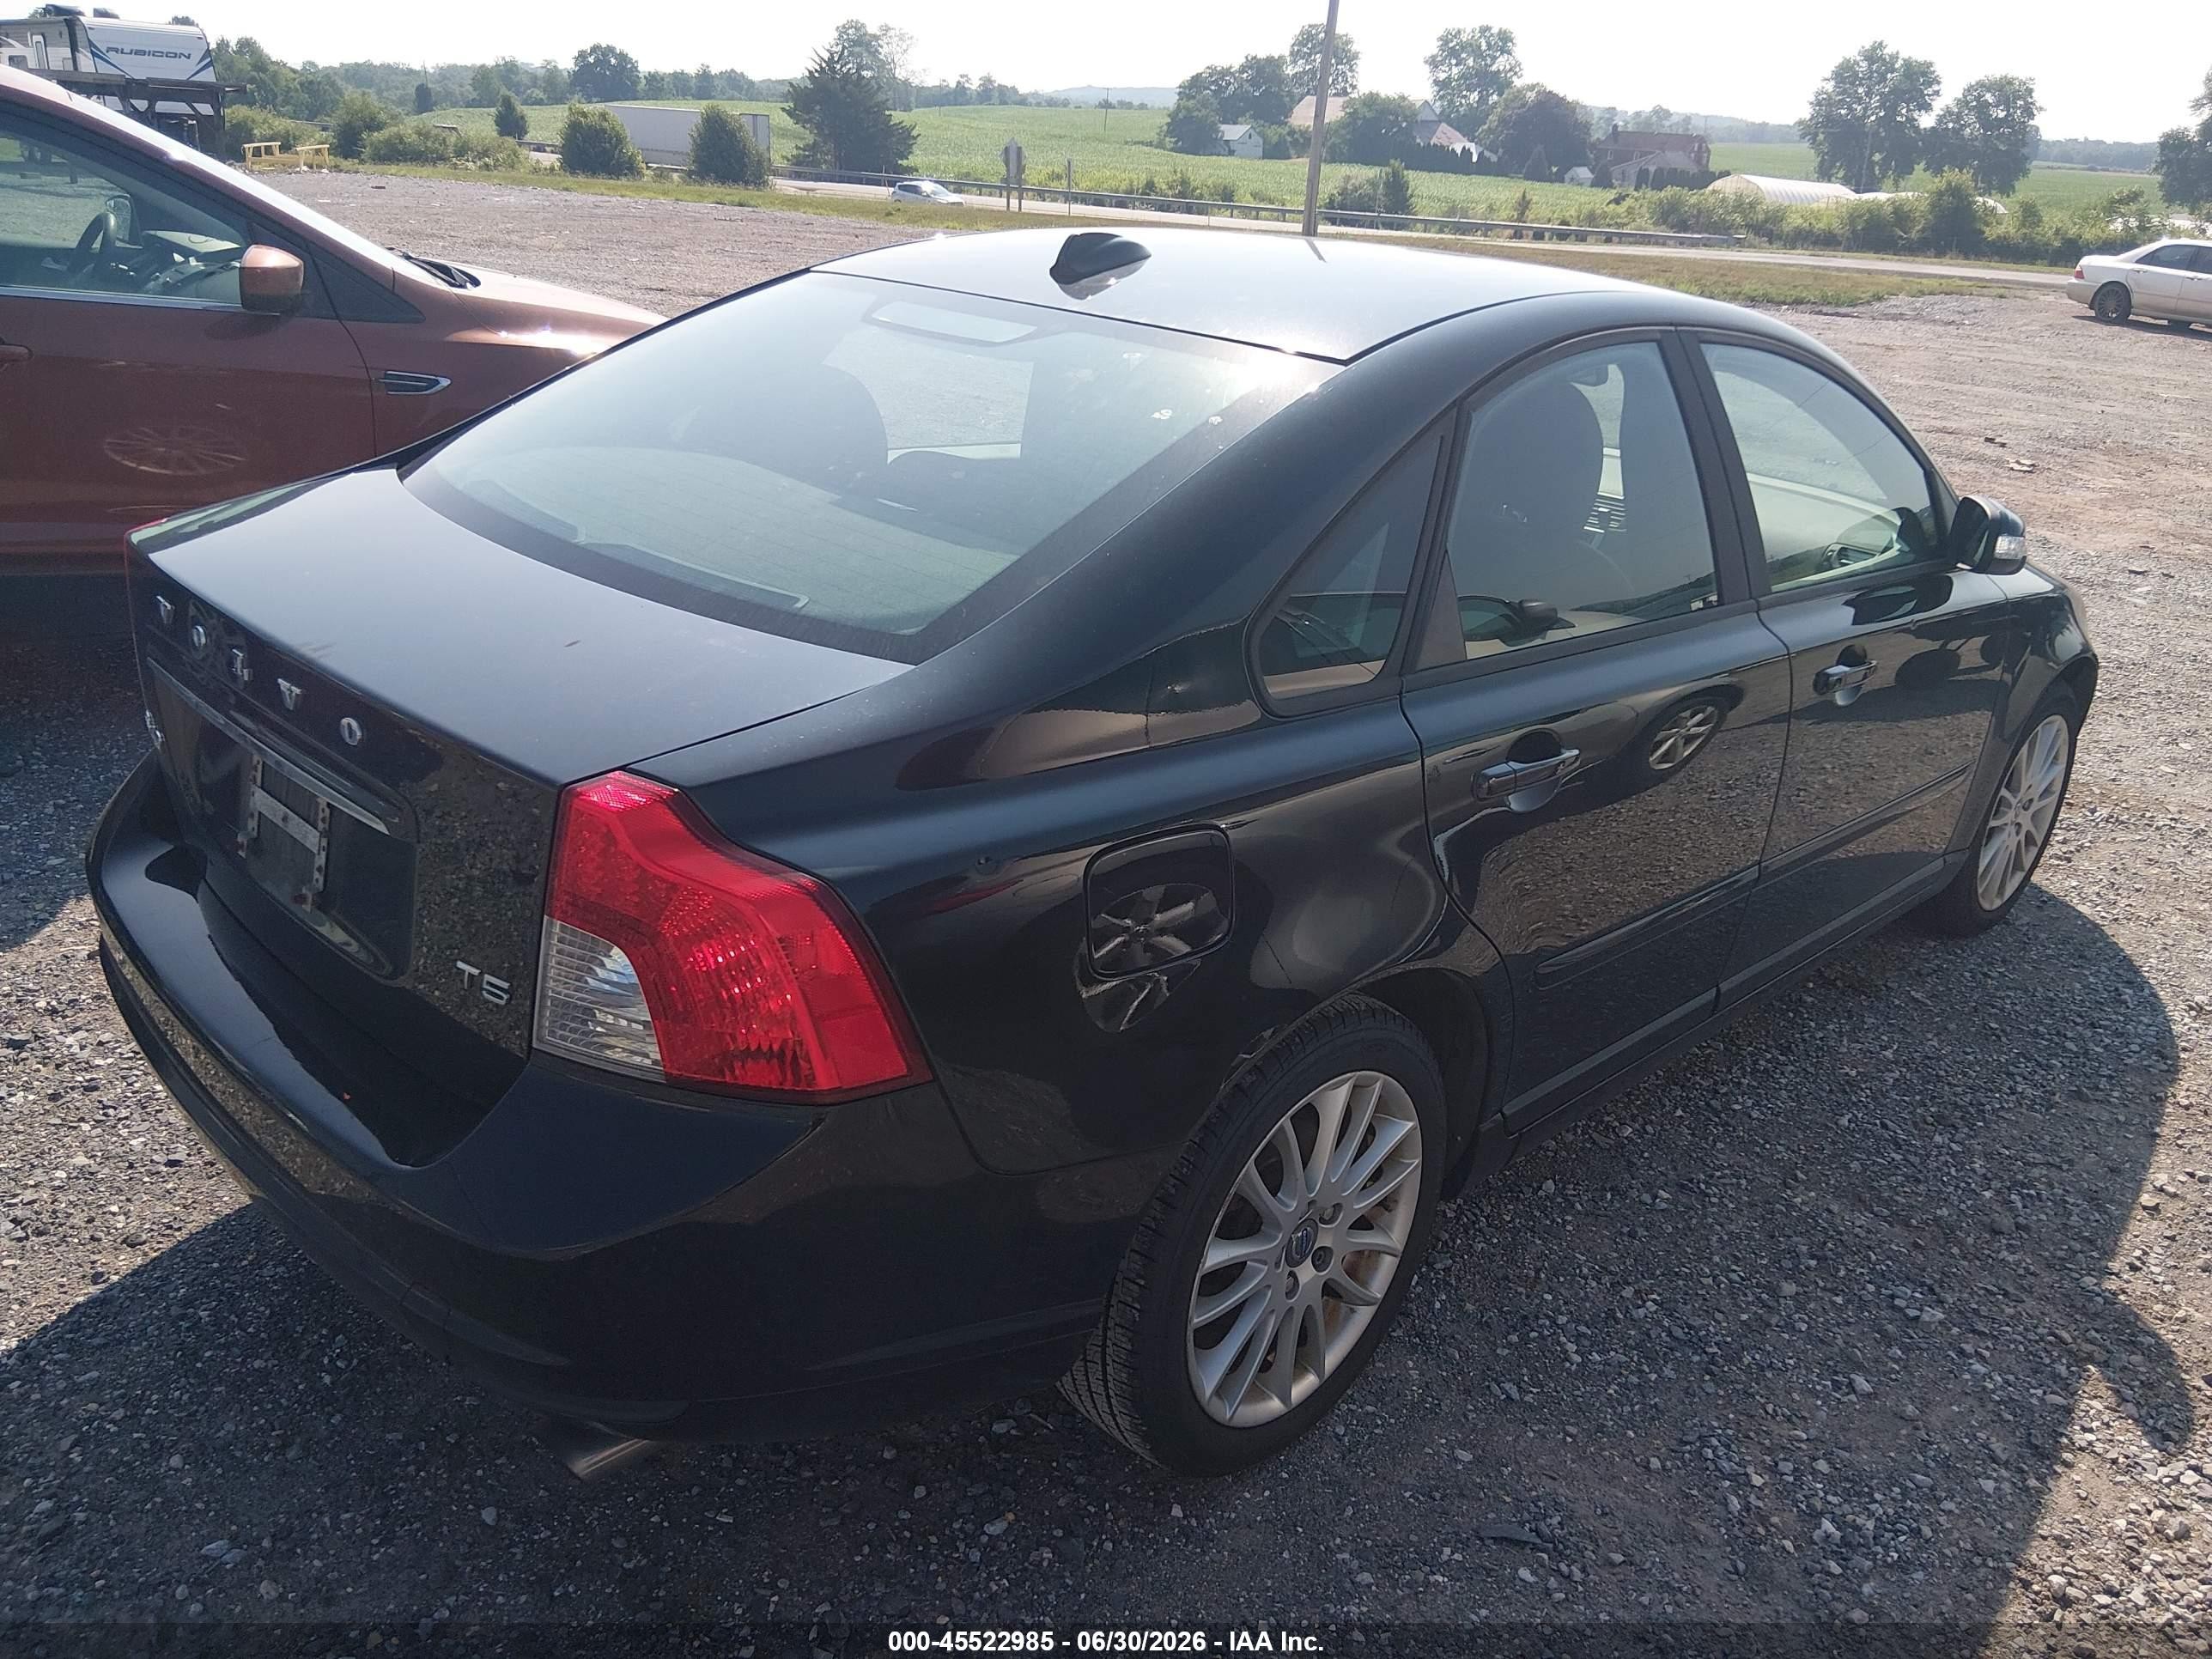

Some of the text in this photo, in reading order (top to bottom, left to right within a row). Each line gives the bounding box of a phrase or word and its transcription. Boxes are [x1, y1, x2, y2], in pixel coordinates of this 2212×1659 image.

[106, 46, 191, 60] RUBICON
[156, 595, 364, 746] VOLVO
[455, 961, 511, 1006] T5
